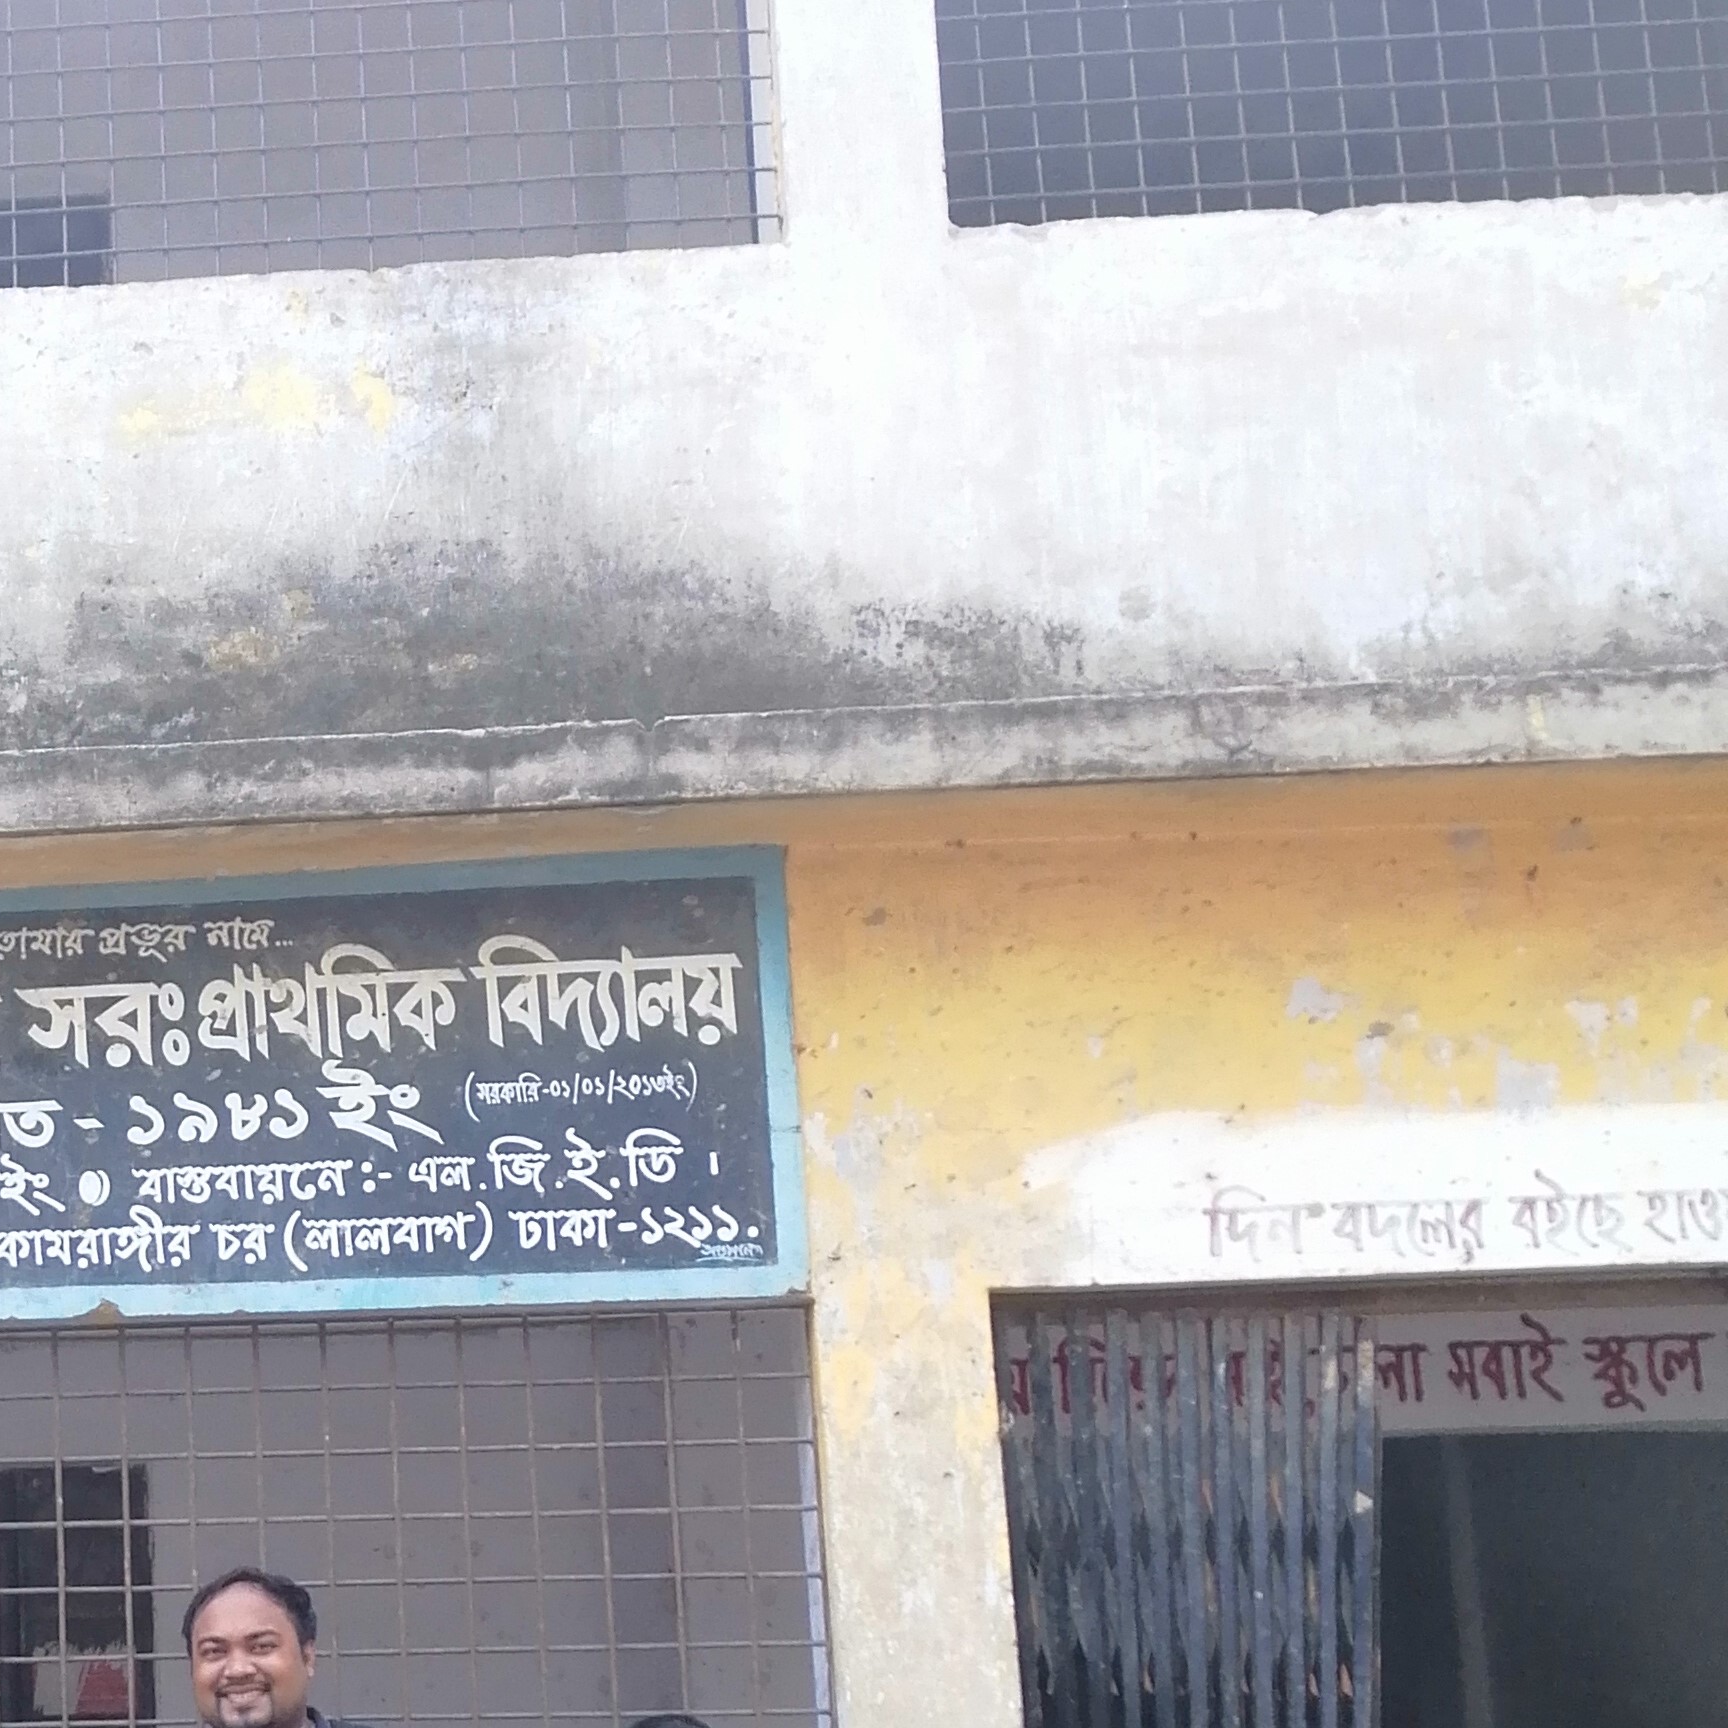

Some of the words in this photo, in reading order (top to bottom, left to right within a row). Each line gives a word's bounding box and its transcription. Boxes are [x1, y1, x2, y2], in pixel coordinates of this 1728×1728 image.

[197, 943, 468, 1061] প্রাথমিক
[470, 933, 744, 1053] বিদ্যালয়
[126, 1088, 309, 1146] ১৯৮১
[316, 1059, 445, 1153] ইং
[208, 1222, 276, 1266] চর
[1331, 1198, 1490, 1265] বদলের
[1508, 1168, 1633, 1256] বইছে
[1636, 1187, 1728, 1244] হাও
[1582, 1331, 1716, 1413] স্কুলে
